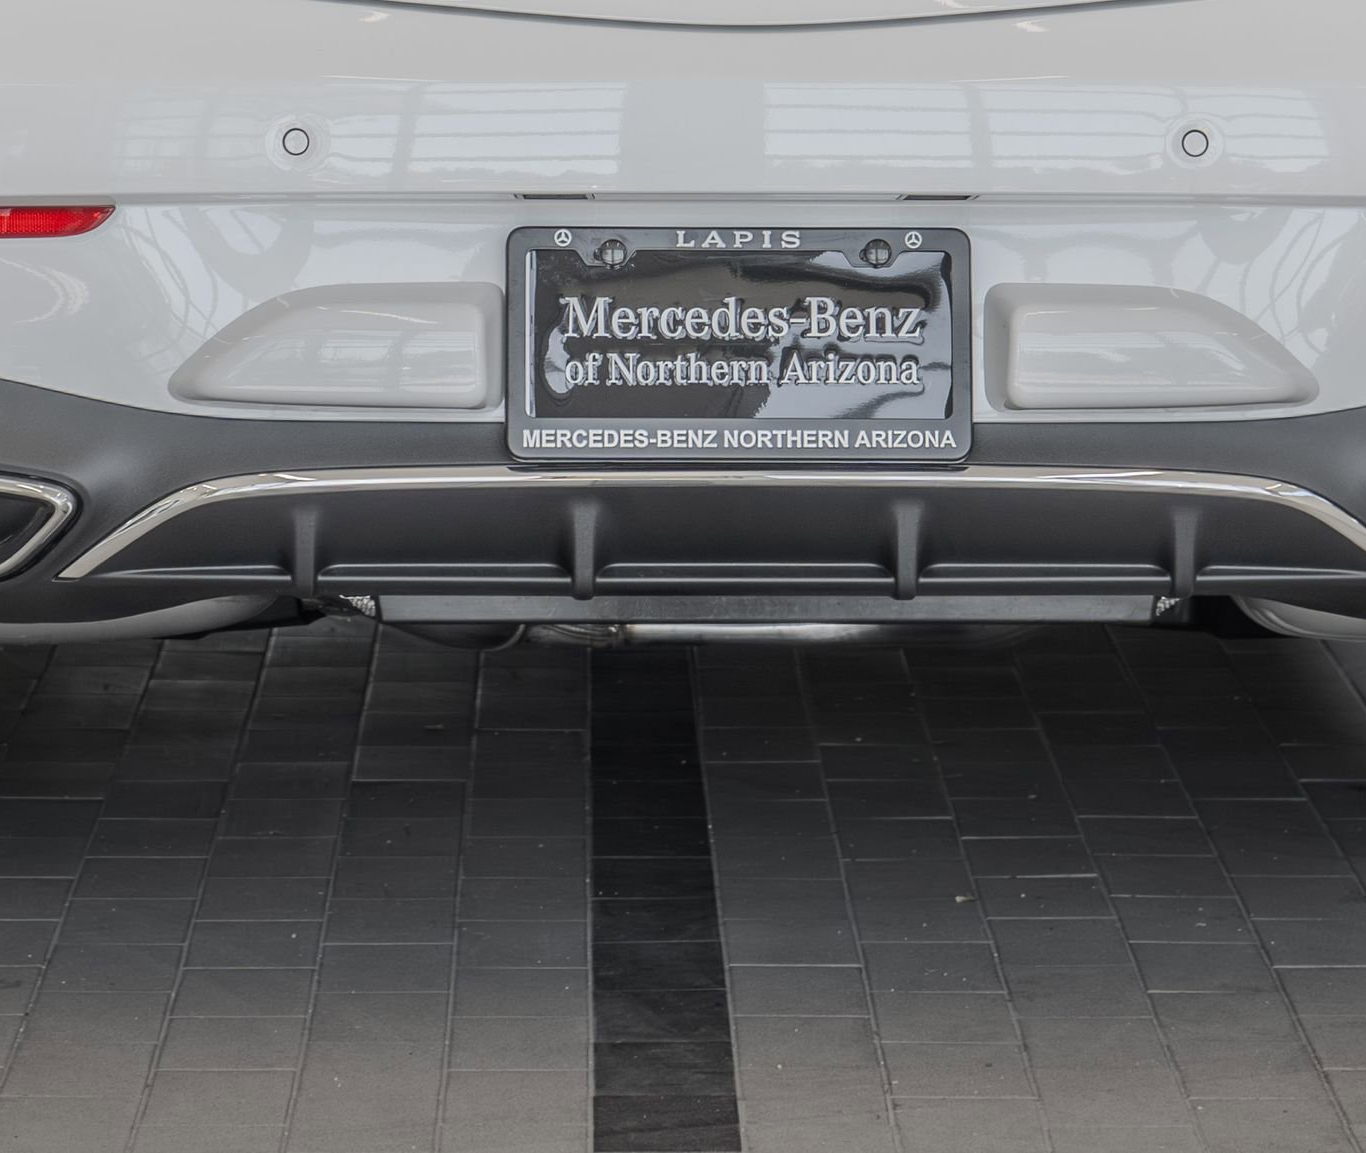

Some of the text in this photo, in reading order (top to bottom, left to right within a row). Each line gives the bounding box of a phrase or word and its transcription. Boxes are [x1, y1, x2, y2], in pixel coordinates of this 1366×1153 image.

[675, 230, 802, 248] LAPIS
[559, 295, 923, 339] Mercedes-Benz
[564, 352, 921, 386] of Northern Arizona
[522, 428, 957, 449] MERCEDES-BENZ NORTHERN ARIZONA
